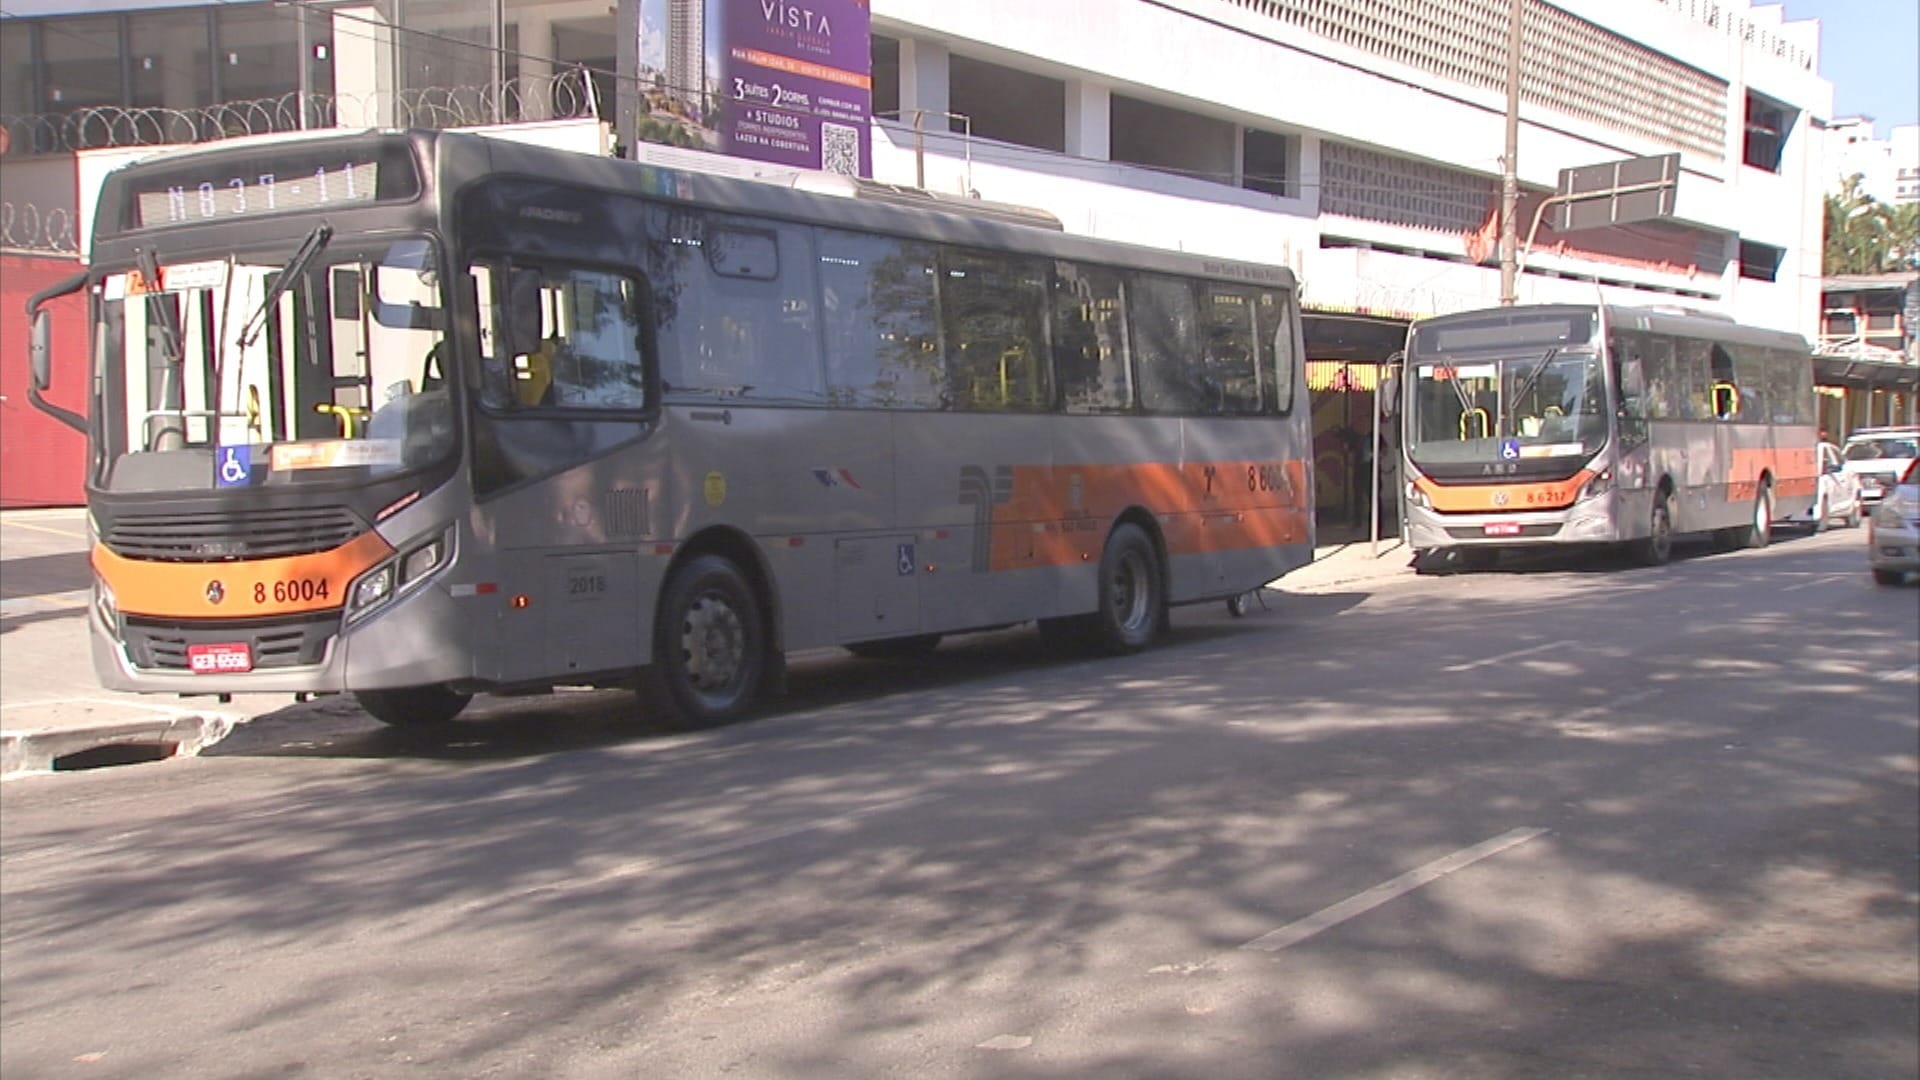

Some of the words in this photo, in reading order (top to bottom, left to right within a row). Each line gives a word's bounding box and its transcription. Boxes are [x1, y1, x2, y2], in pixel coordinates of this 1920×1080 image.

[733, 77, 744, 99] 3
[744, 83, 769, 97] SUÍTES
[771, 84, 782, 106] 2
[755, 110, 800, 129] STUDIOS
[735, 132, 757, 144] LAZER
[760, 137, 769, 146] NA
[771, 138, 810, 152] COBERTURA
[254, 582, 266, 604] 8
[274, 578, 329, 603] 6004
